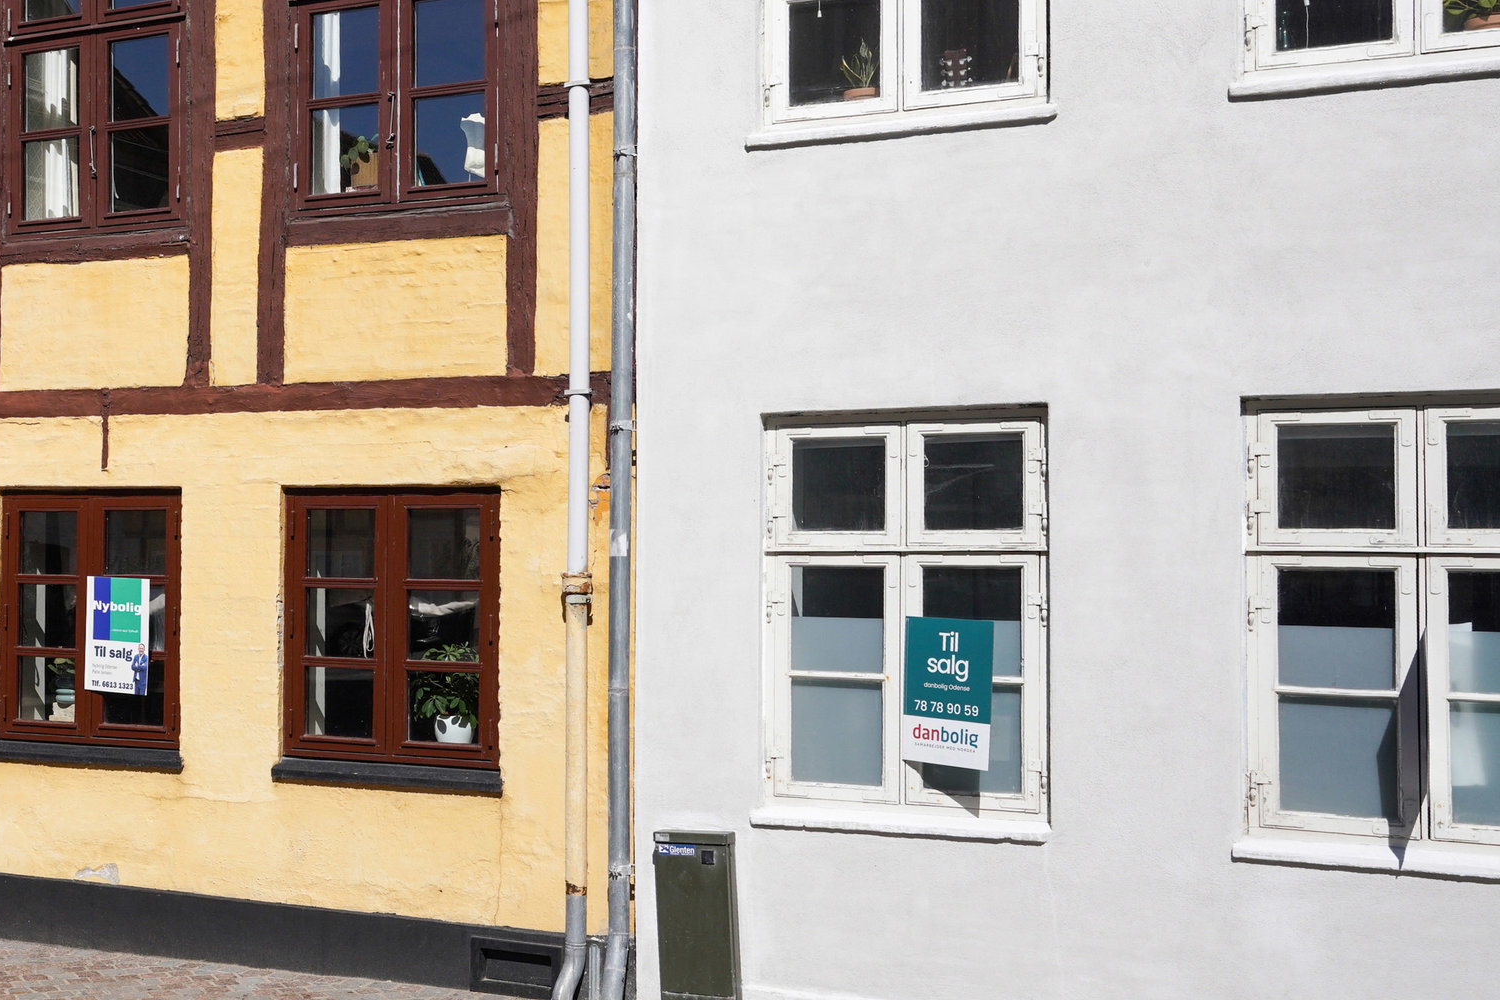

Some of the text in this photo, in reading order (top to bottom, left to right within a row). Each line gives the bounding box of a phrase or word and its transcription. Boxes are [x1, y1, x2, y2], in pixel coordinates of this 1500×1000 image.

[93, 600, 142, 616] Nybolig
[938, 631, 959, 652] Til
[94, 645, 133, 662] Til salg
[927, 655, 969, 682] salg
[102, 680, 117, 689] 6613
[923, 682, 971, 692] danbolig Odense
[914, 699, 979, 717] 78 78 90 59
[912, 723, 979, 749] danbolig
